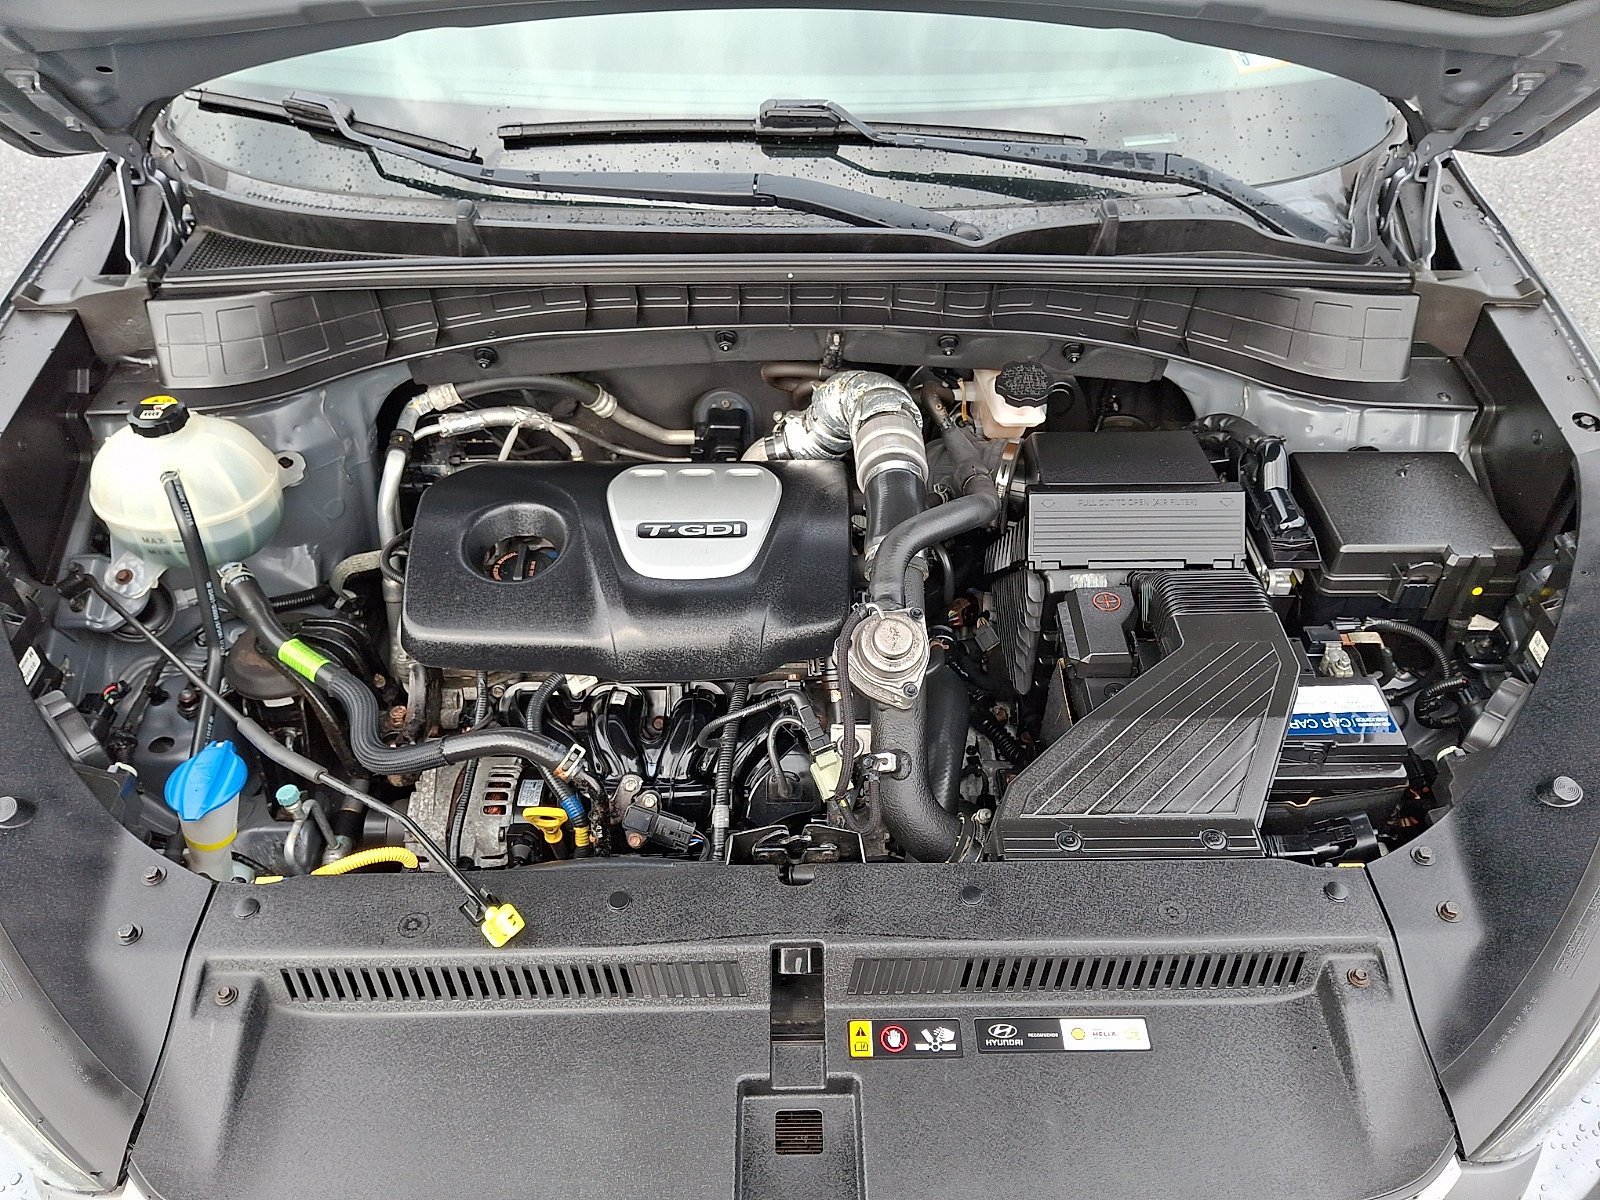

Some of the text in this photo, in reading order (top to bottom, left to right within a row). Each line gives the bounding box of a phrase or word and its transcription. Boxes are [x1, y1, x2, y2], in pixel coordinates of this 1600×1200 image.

[643, 523, 741, 537] T-GDI
[141, 536, 165, 544] MAX
[1289, 718, 1352, 729] CAR CAR
